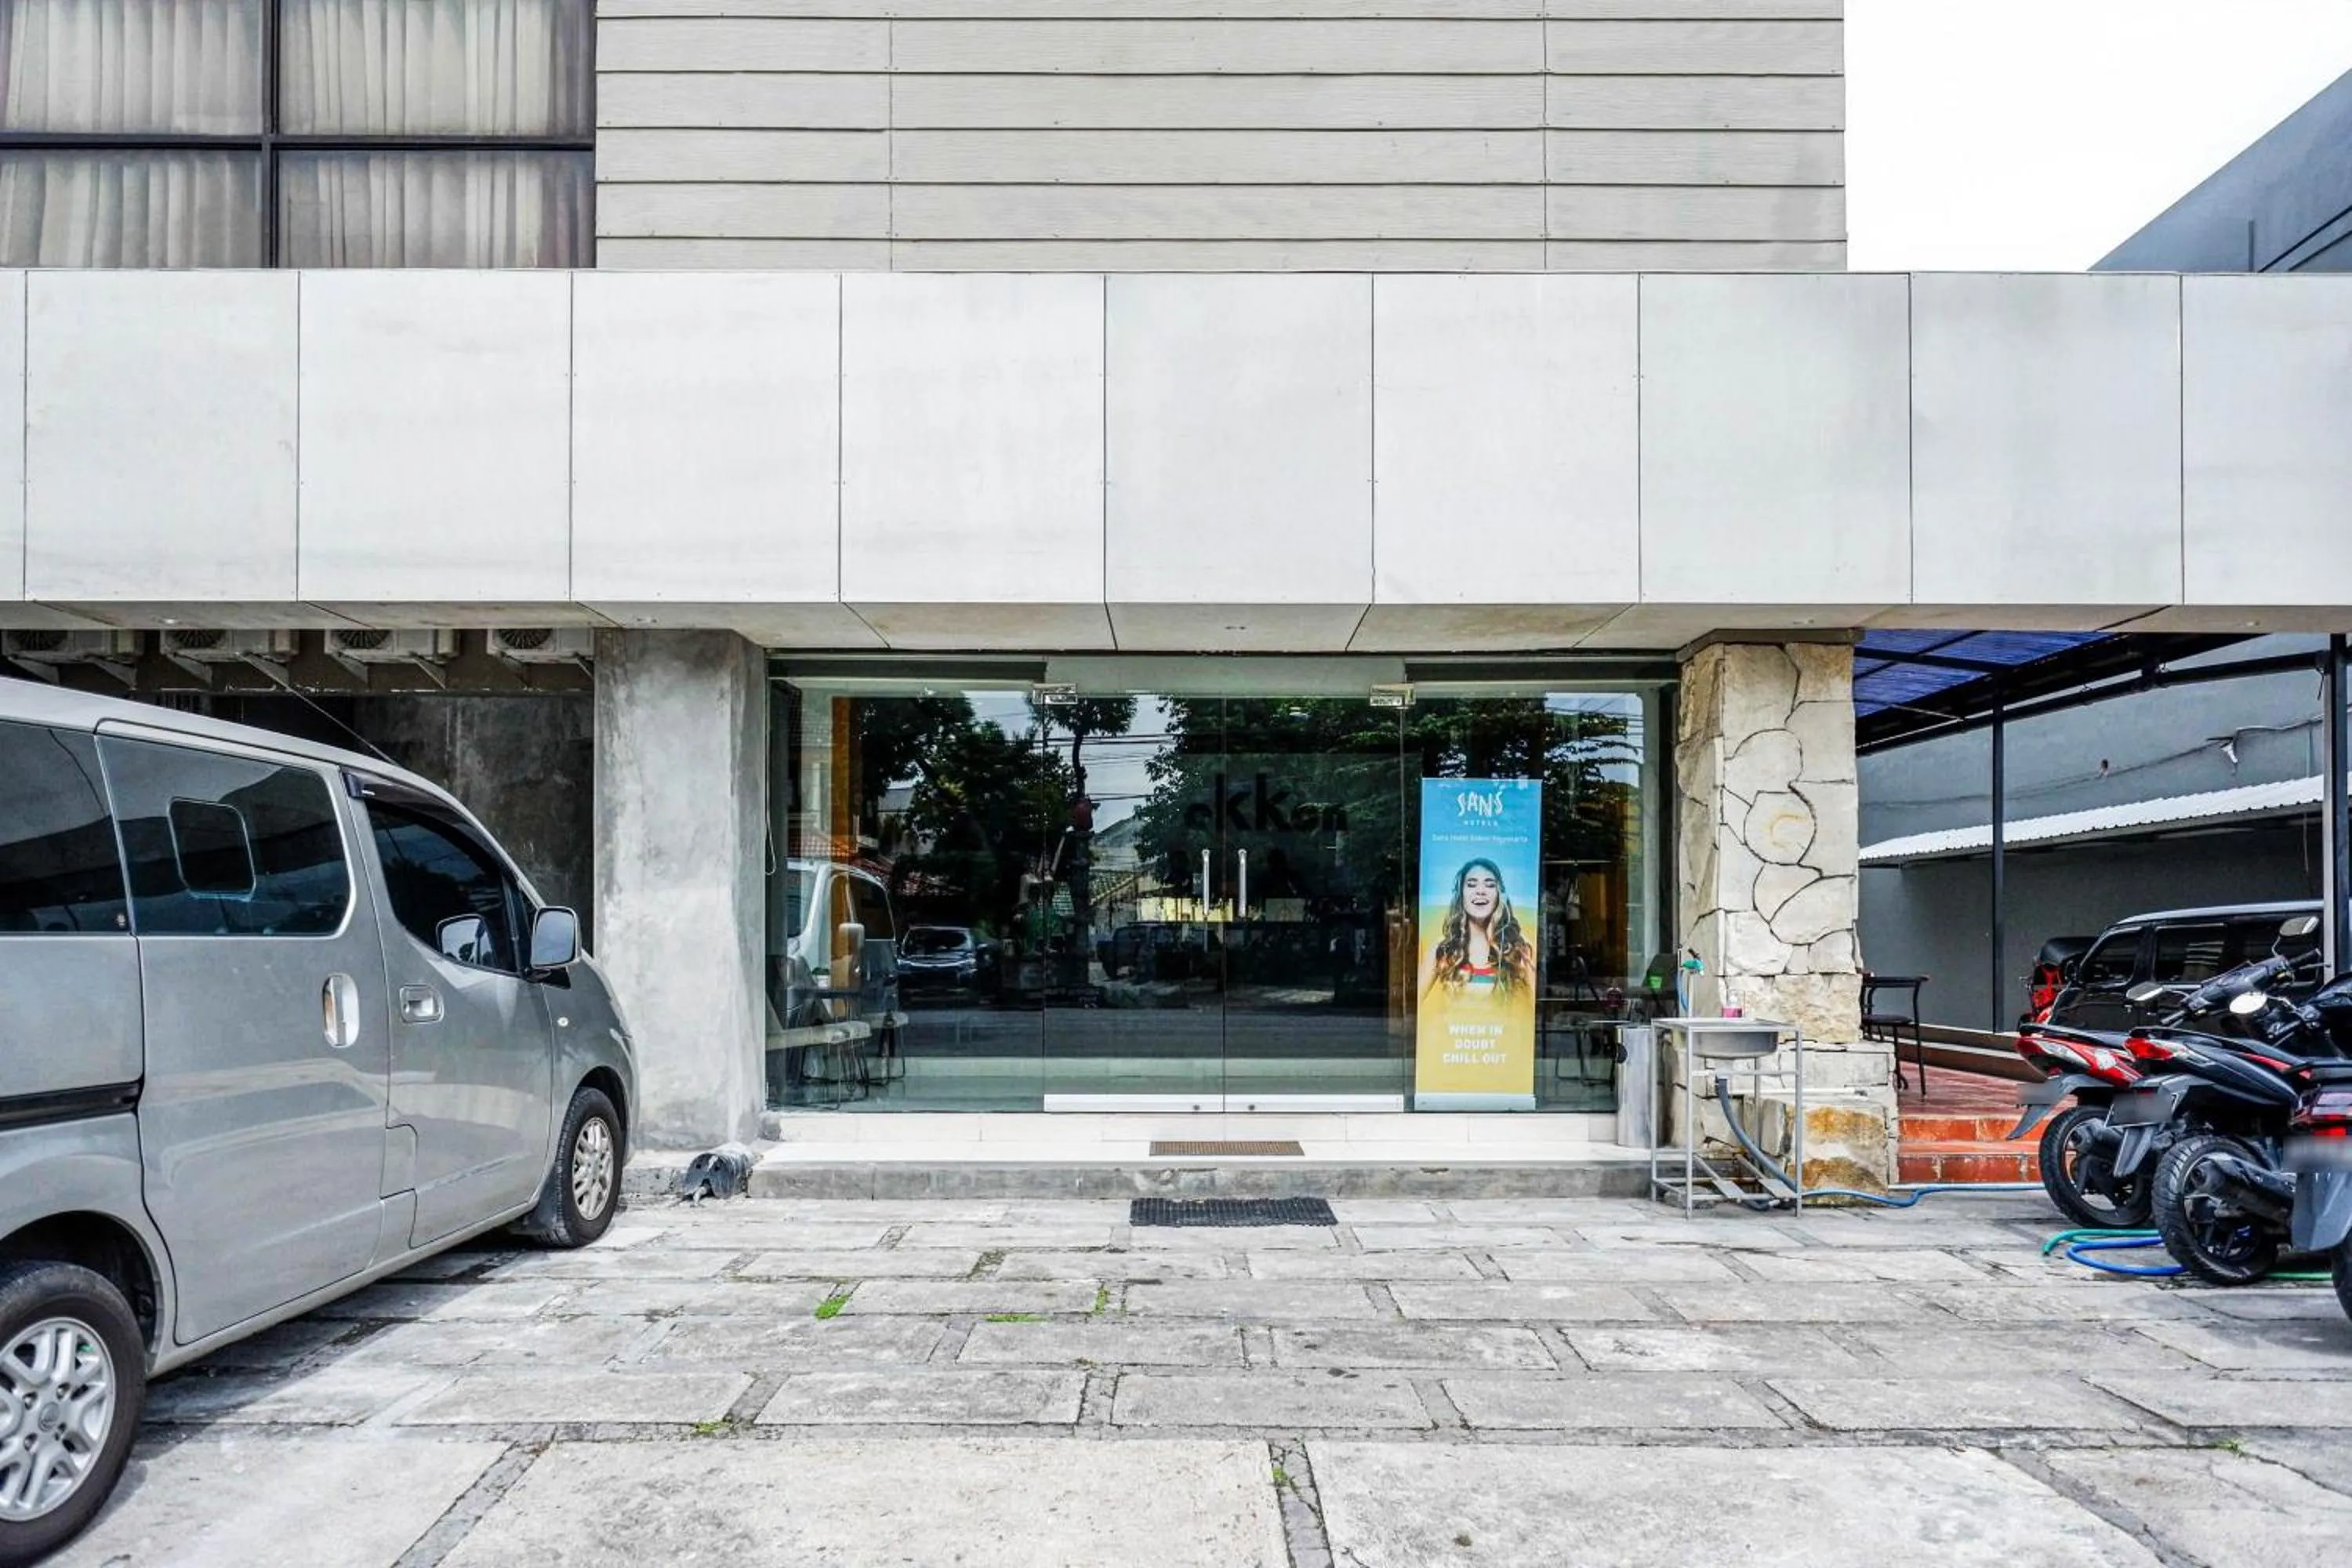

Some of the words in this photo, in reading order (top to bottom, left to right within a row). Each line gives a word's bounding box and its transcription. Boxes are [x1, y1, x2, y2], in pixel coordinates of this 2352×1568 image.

[1457, 790, 1504, 817] SANS
[1448, 1024, 1486, 1035] WHEN
[1490, 1025, 1504, 1035] IN
[1454, 1040, 1496, 1049] DOUBT
[1443, 1053, 1480, 1064] CHILL
[1483, 1053, 1508, 1064] OUT
